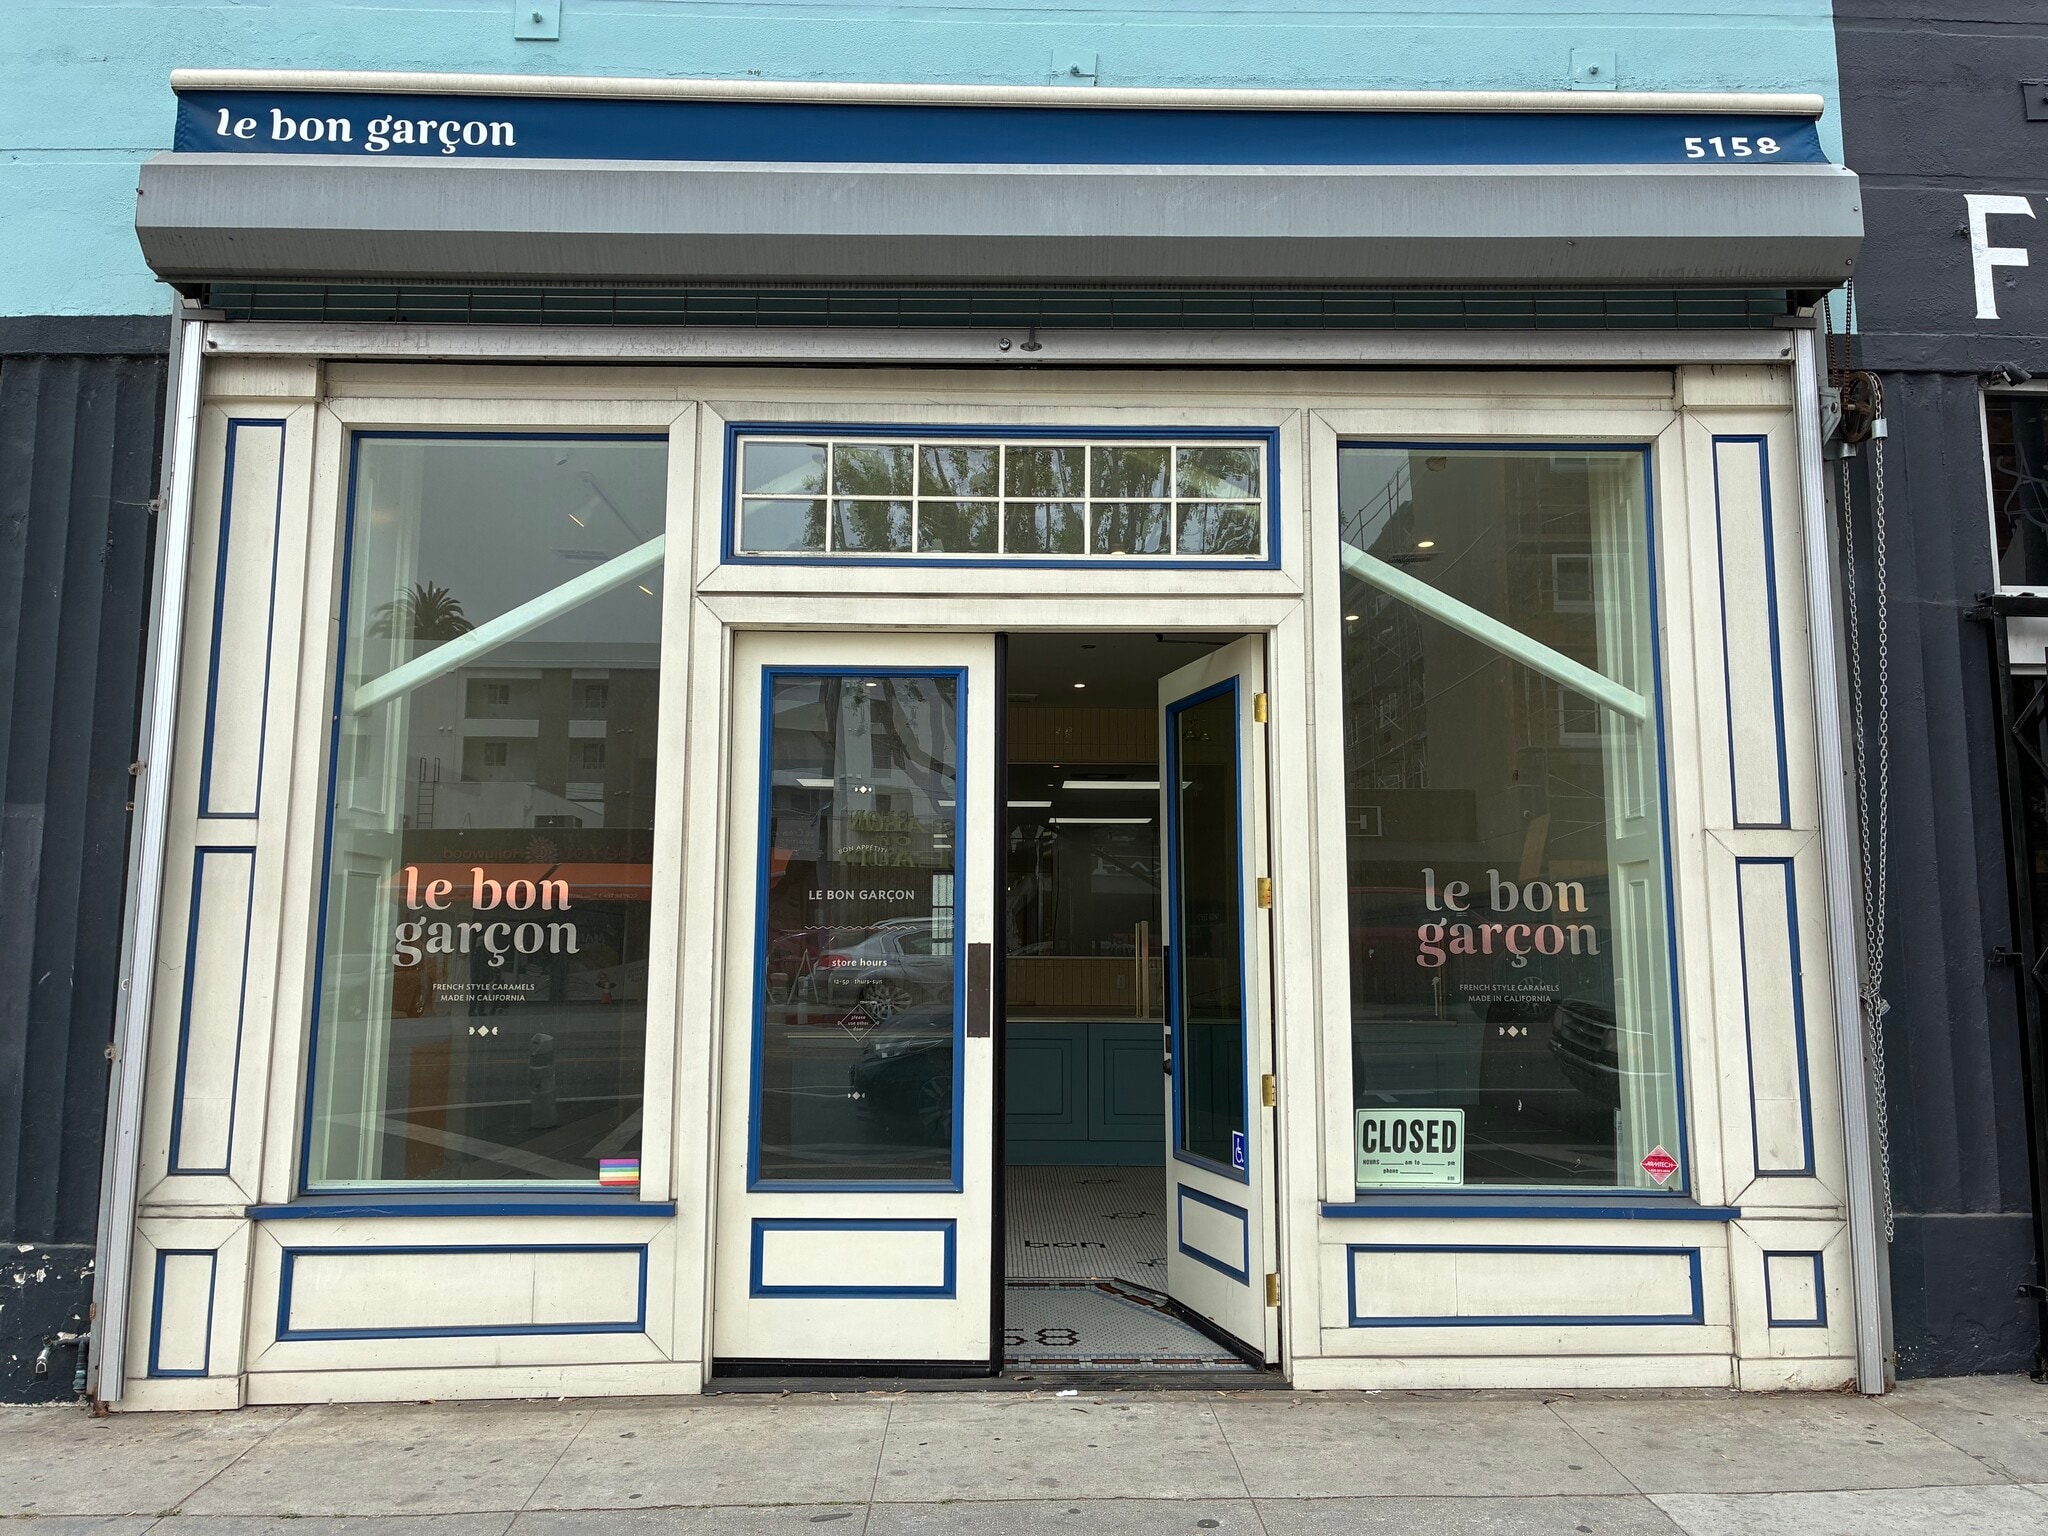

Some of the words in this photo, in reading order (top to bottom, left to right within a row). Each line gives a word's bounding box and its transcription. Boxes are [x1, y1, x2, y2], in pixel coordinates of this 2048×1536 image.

[215, 108, 257, 139] le
[271, 108, 352, 142] bon
[364, 114, 516, 154] garçon
[1685, 137, 1780, 158] 5158
[1963, 194, 2048, 319] F
[838, 845, 854, 855] BON
[404, 866, 453, 910] le
[470, 867, 572, 911] bon
[808, 890, 823, 900] LE
[827, 890, 855, 900] BON
[859, 890, 915, 903] GARÇON
[1421, 868, 1471, 912] le
[1486, 869, 1588, 912] bon
[392, 917, 580, 967] garçon
[1416, 917, 1601, 968] garçon
[832, 959, 857, 967] store
[860, 958, 888, 967] hours
[432, 983, 465, 991] FRENCH
[465, 983, 491, 991] STYLE
[491, 983, 535, 991] CARAMELS
[1459, 984, 1491, 992] FRENCH
[1491, 984, 1516, 992] STYLE
[1517, 984, 1560, 992] CARAMELS
[440, 994, 465, 1002] MADE
[465, 994, 475, 1002] IN
[476, 994, 526, 1002] CALIFORNIA
[1468, 995, 1492, 1003] MADE
[1493, 995, 1502, 1003] IN
[1503, 995, 1552, 1003] CALIFORNIA
[1362, 1119, 1457, 1154] CLOSED
[1025, 1240, 1106, 1248] bon
